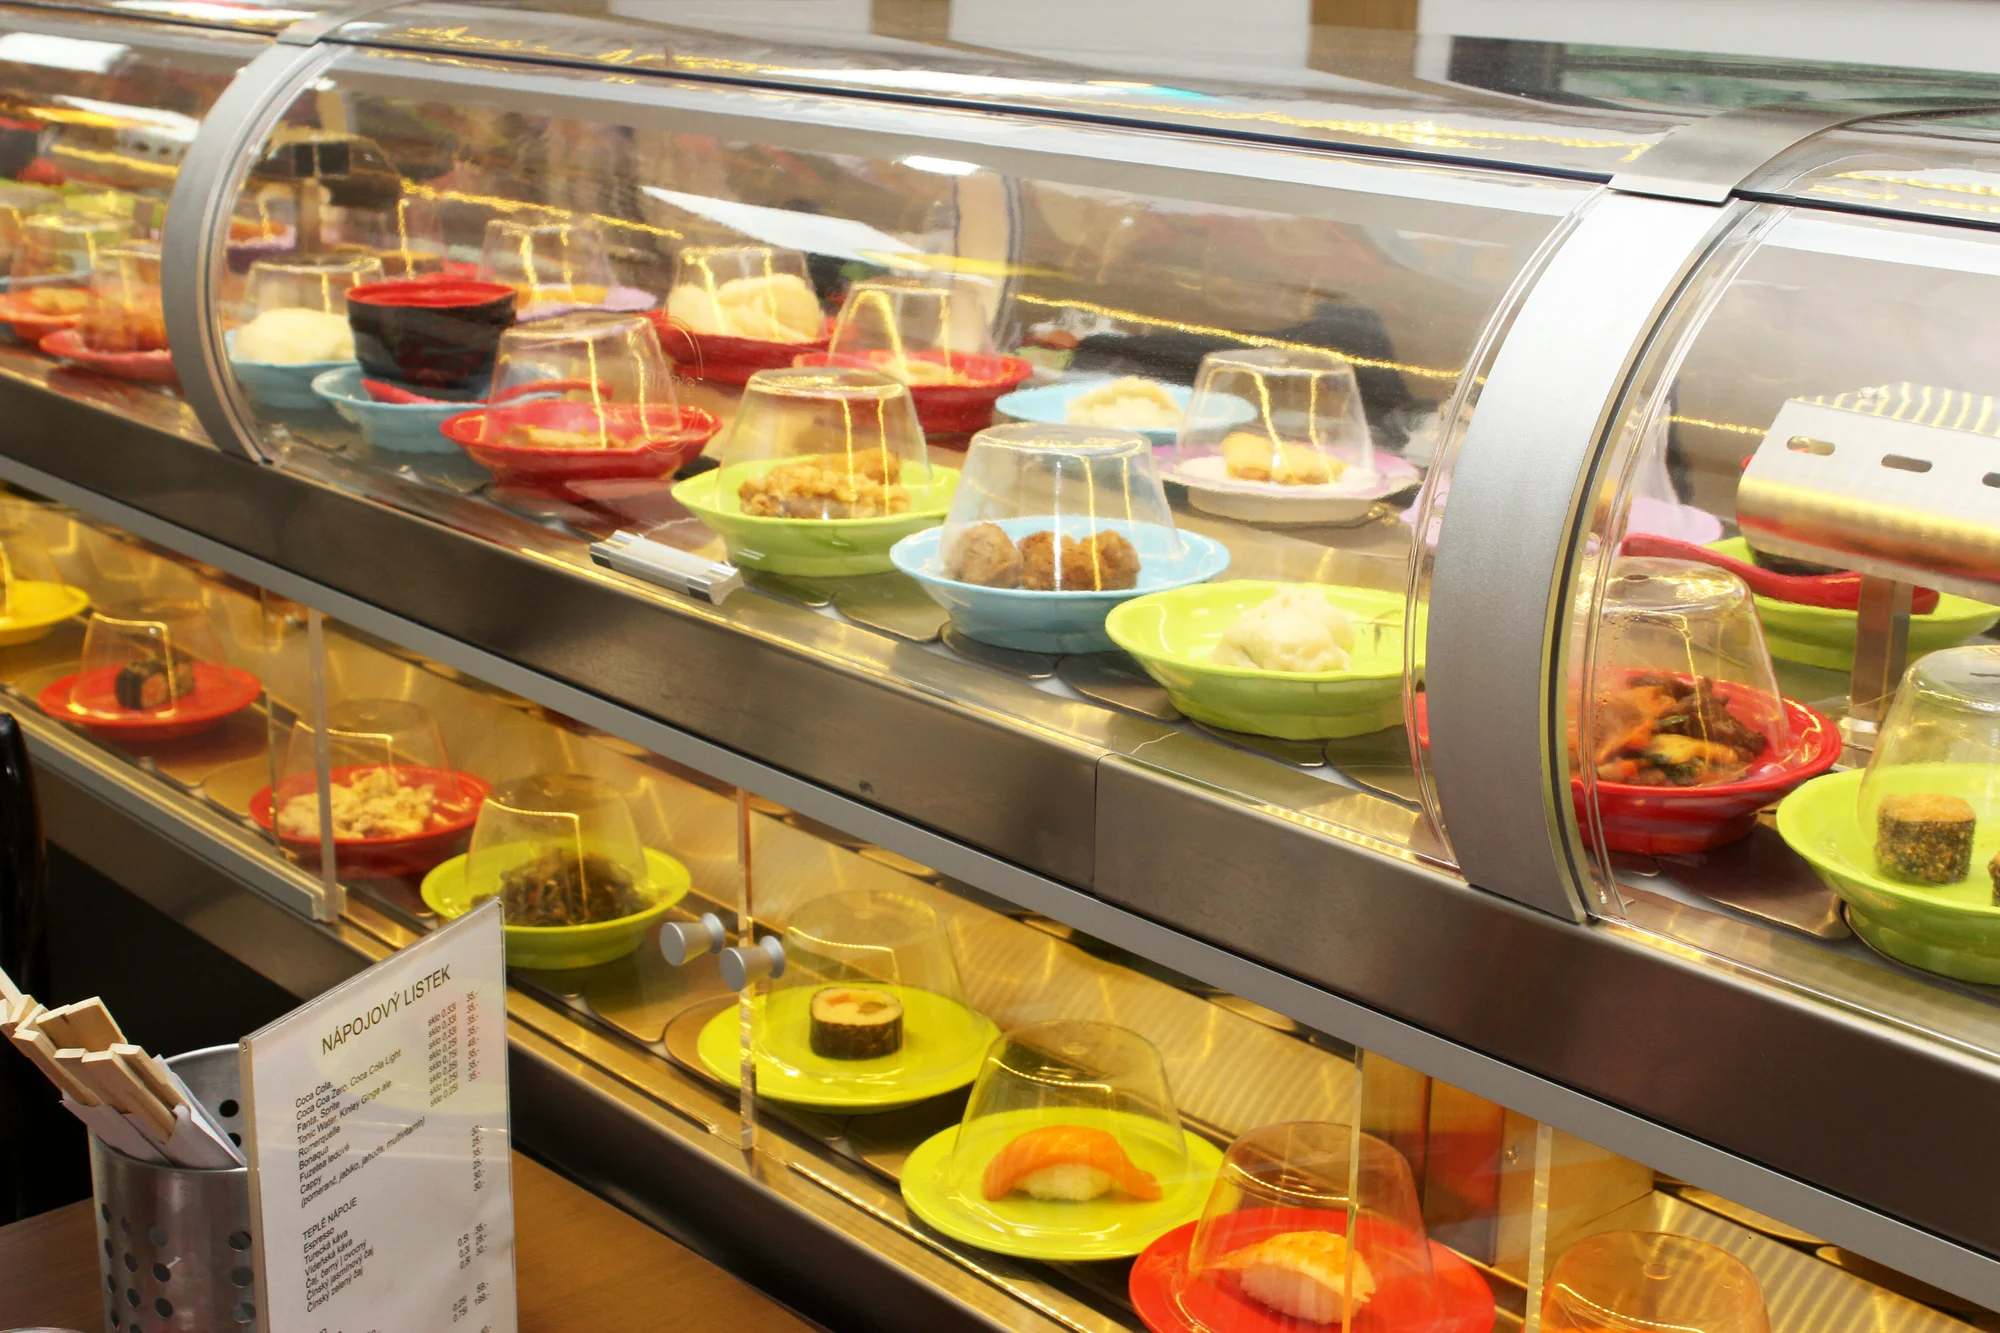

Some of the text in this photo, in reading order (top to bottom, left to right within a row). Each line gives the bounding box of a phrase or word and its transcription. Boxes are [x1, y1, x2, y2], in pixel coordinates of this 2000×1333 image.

[322, 964, 451, 1055] NÁPOJOVÝ LISTEK
[295, 1093, 314, 1108] Coca
[428, 1014, 441, 1026] sklo
[296, 1105, 315, 1120] Coca
[350, 1071, 368, 1086] Coca
[369, 1060, 384, 1075] Cola
[385, 1049, 402, 1065] Light
[428, 1026, 441, 1038] sklo
[320, 1101, 340, 1118] Sprite
[428, 1037, 441, 1050] sklo
[429, 1060, 442, 1073] sklo
[297, 1129, 316, 1144] Tonic
[340, 1100, 360, 1118] Kinley
[361, 1087, 381, 1104] Ginge
[381, 1080, 392, 1091] ale
[428, 1049, 441, 1061] sklo
[299, 1146, 329, 1171] Bonaqua
[429, 1072, 442, 1084] sklo
[299, 1159, 327, 1182] Fuzetea
[429, 1083, 442, 1096] sklo
[300, 1175, 322, 1194] Cappy
[430, 1095, 442, 1107] sklo
[302, 1197, 357, 1240] TEPLÉ NÁPOJE
[303, 1227, 335, 1253] Espresso
[304, 1240, 331, 1264] Turecká
[332, 1229, 348, 1245] káva
[336, 1238, 353, 1254] káva
[343, 1238, 367, 1261] ovocný
[331, 1274, 352, 1296] zelený
[353, 1265, 364, 1279] čaj
[364, 1245, 374, 1259] čaj
